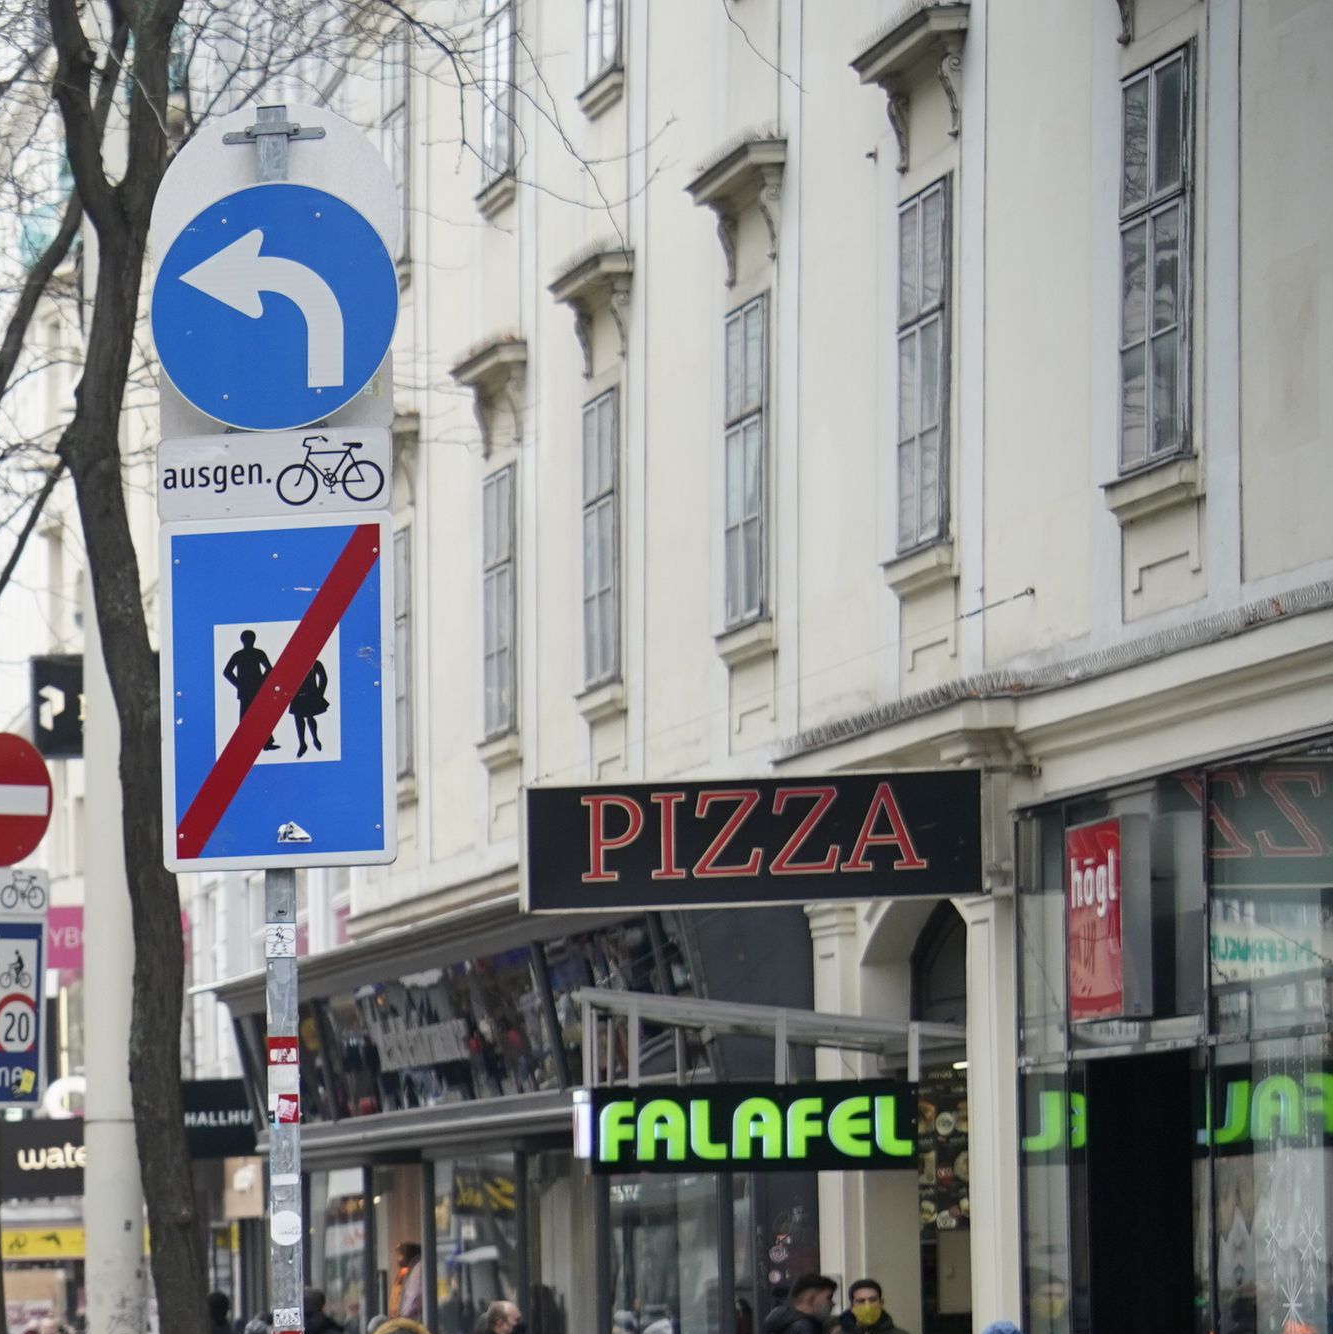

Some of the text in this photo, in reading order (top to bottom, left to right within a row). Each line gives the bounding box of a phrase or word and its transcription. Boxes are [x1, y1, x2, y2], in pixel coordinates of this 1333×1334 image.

[162, 462, 273, 494] ausgen.
[580, 781, 928, 884] PIZZA
[3, 1012, 30, 1042] 20
[598, 1096, 913, 1163] FALAFEL
